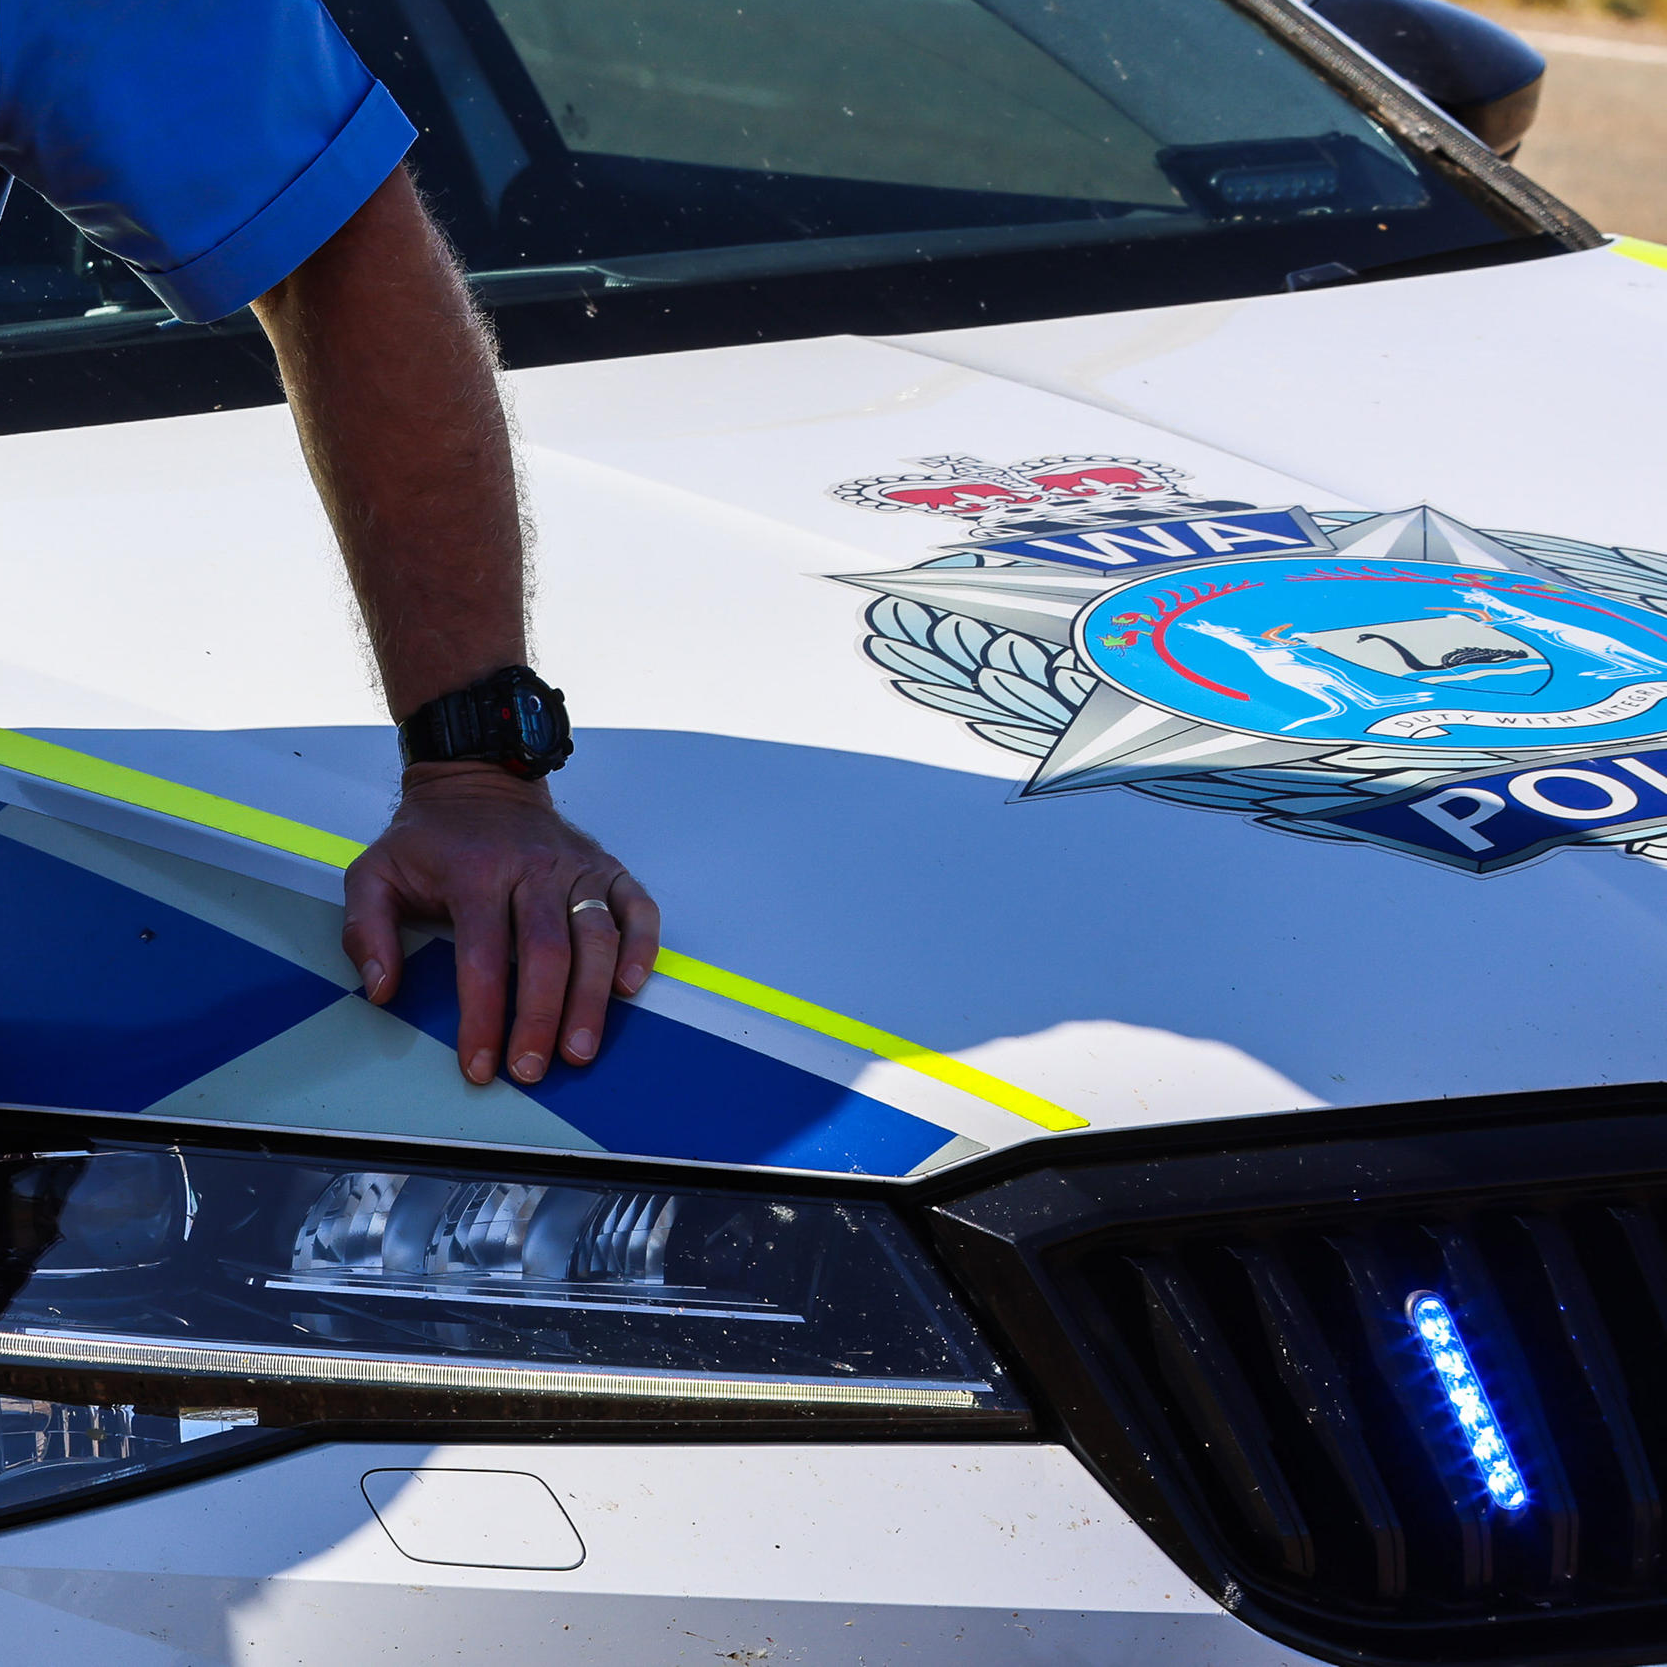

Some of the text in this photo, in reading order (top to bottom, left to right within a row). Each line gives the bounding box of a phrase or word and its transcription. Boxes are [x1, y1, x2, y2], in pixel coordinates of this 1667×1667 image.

[1025, 521, 1308, 565] WA
[1395, 685, 1667, 729] DUTY WITH INTEGRI
